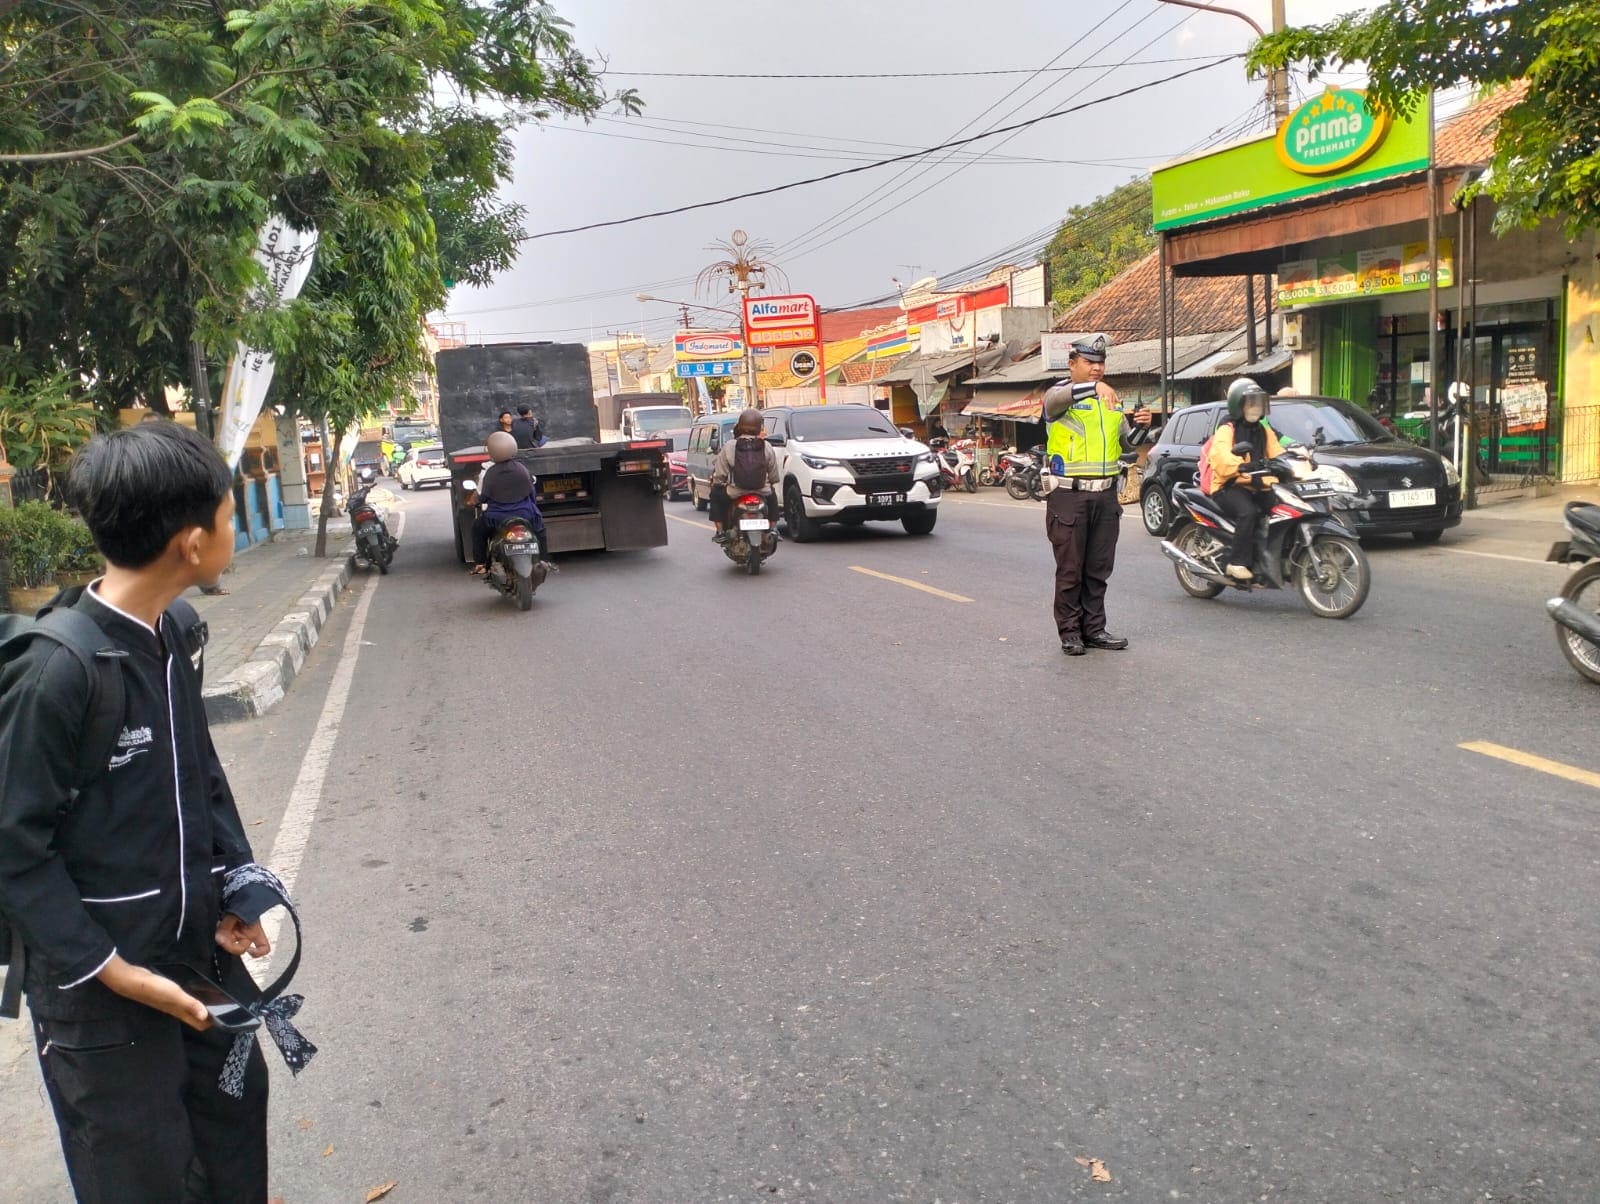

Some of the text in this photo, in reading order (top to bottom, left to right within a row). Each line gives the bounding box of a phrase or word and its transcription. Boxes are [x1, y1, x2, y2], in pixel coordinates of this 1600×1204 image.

[1296, 113, 1362, 153] prima
[1303, 138, 1357, 158] FRESHMART
[752, 301, 810, 315] Alfamart
[689, 341, 729, 351] Indomaret
